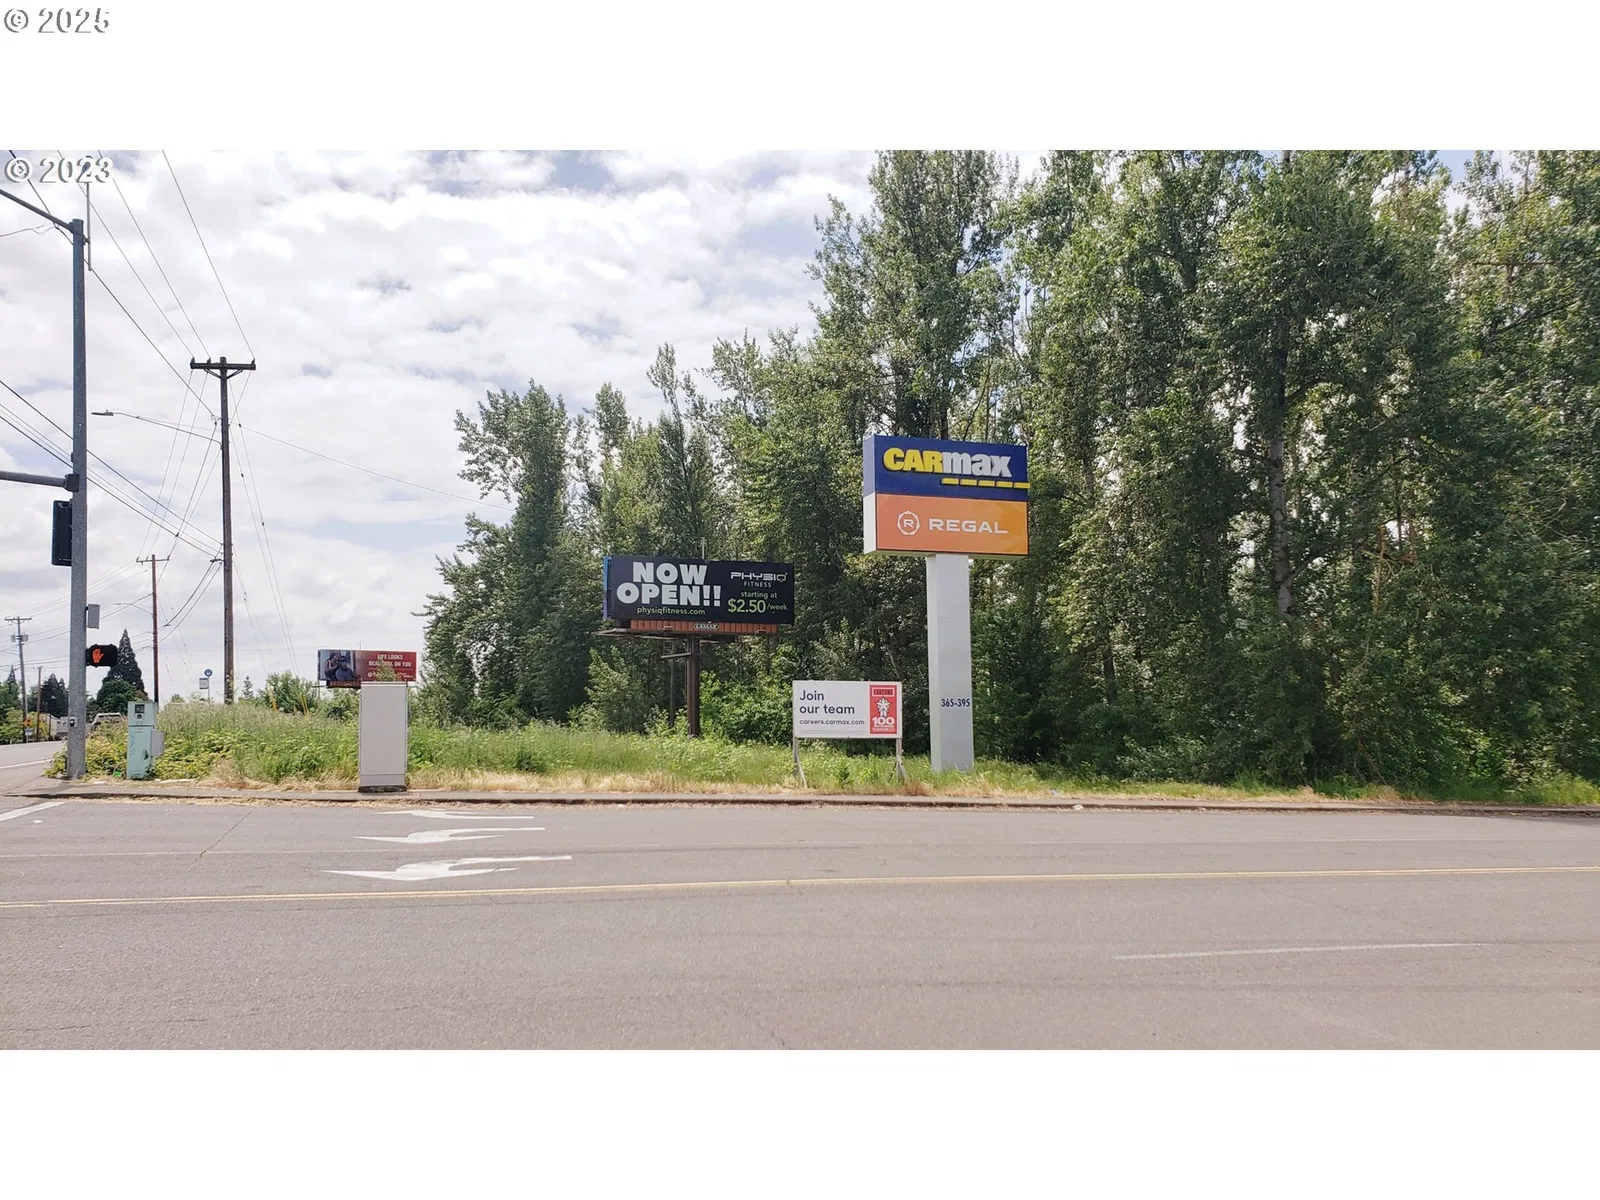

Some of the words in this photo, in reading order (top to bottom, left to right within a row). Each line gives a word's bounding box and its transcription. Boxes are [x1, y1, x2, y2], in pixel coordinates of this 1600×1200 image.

[929, 518, 1008, 534] REGAL
[632, 561, 707, 585] NOW
[730, 571, 787, 583] PHYSIQ
[616, 582, 721, 607] OPEN!!
[740, 591, 769, 599] starting
[636, 606, 706, 616] physiqfitness.com
[799, 689, 825, 701] Join
[940, 698, 970, 707] 365-395
[799, 705, 820, 714] our
[824, 704, 855, 714] team
[872, 716, 895, 725] 100
